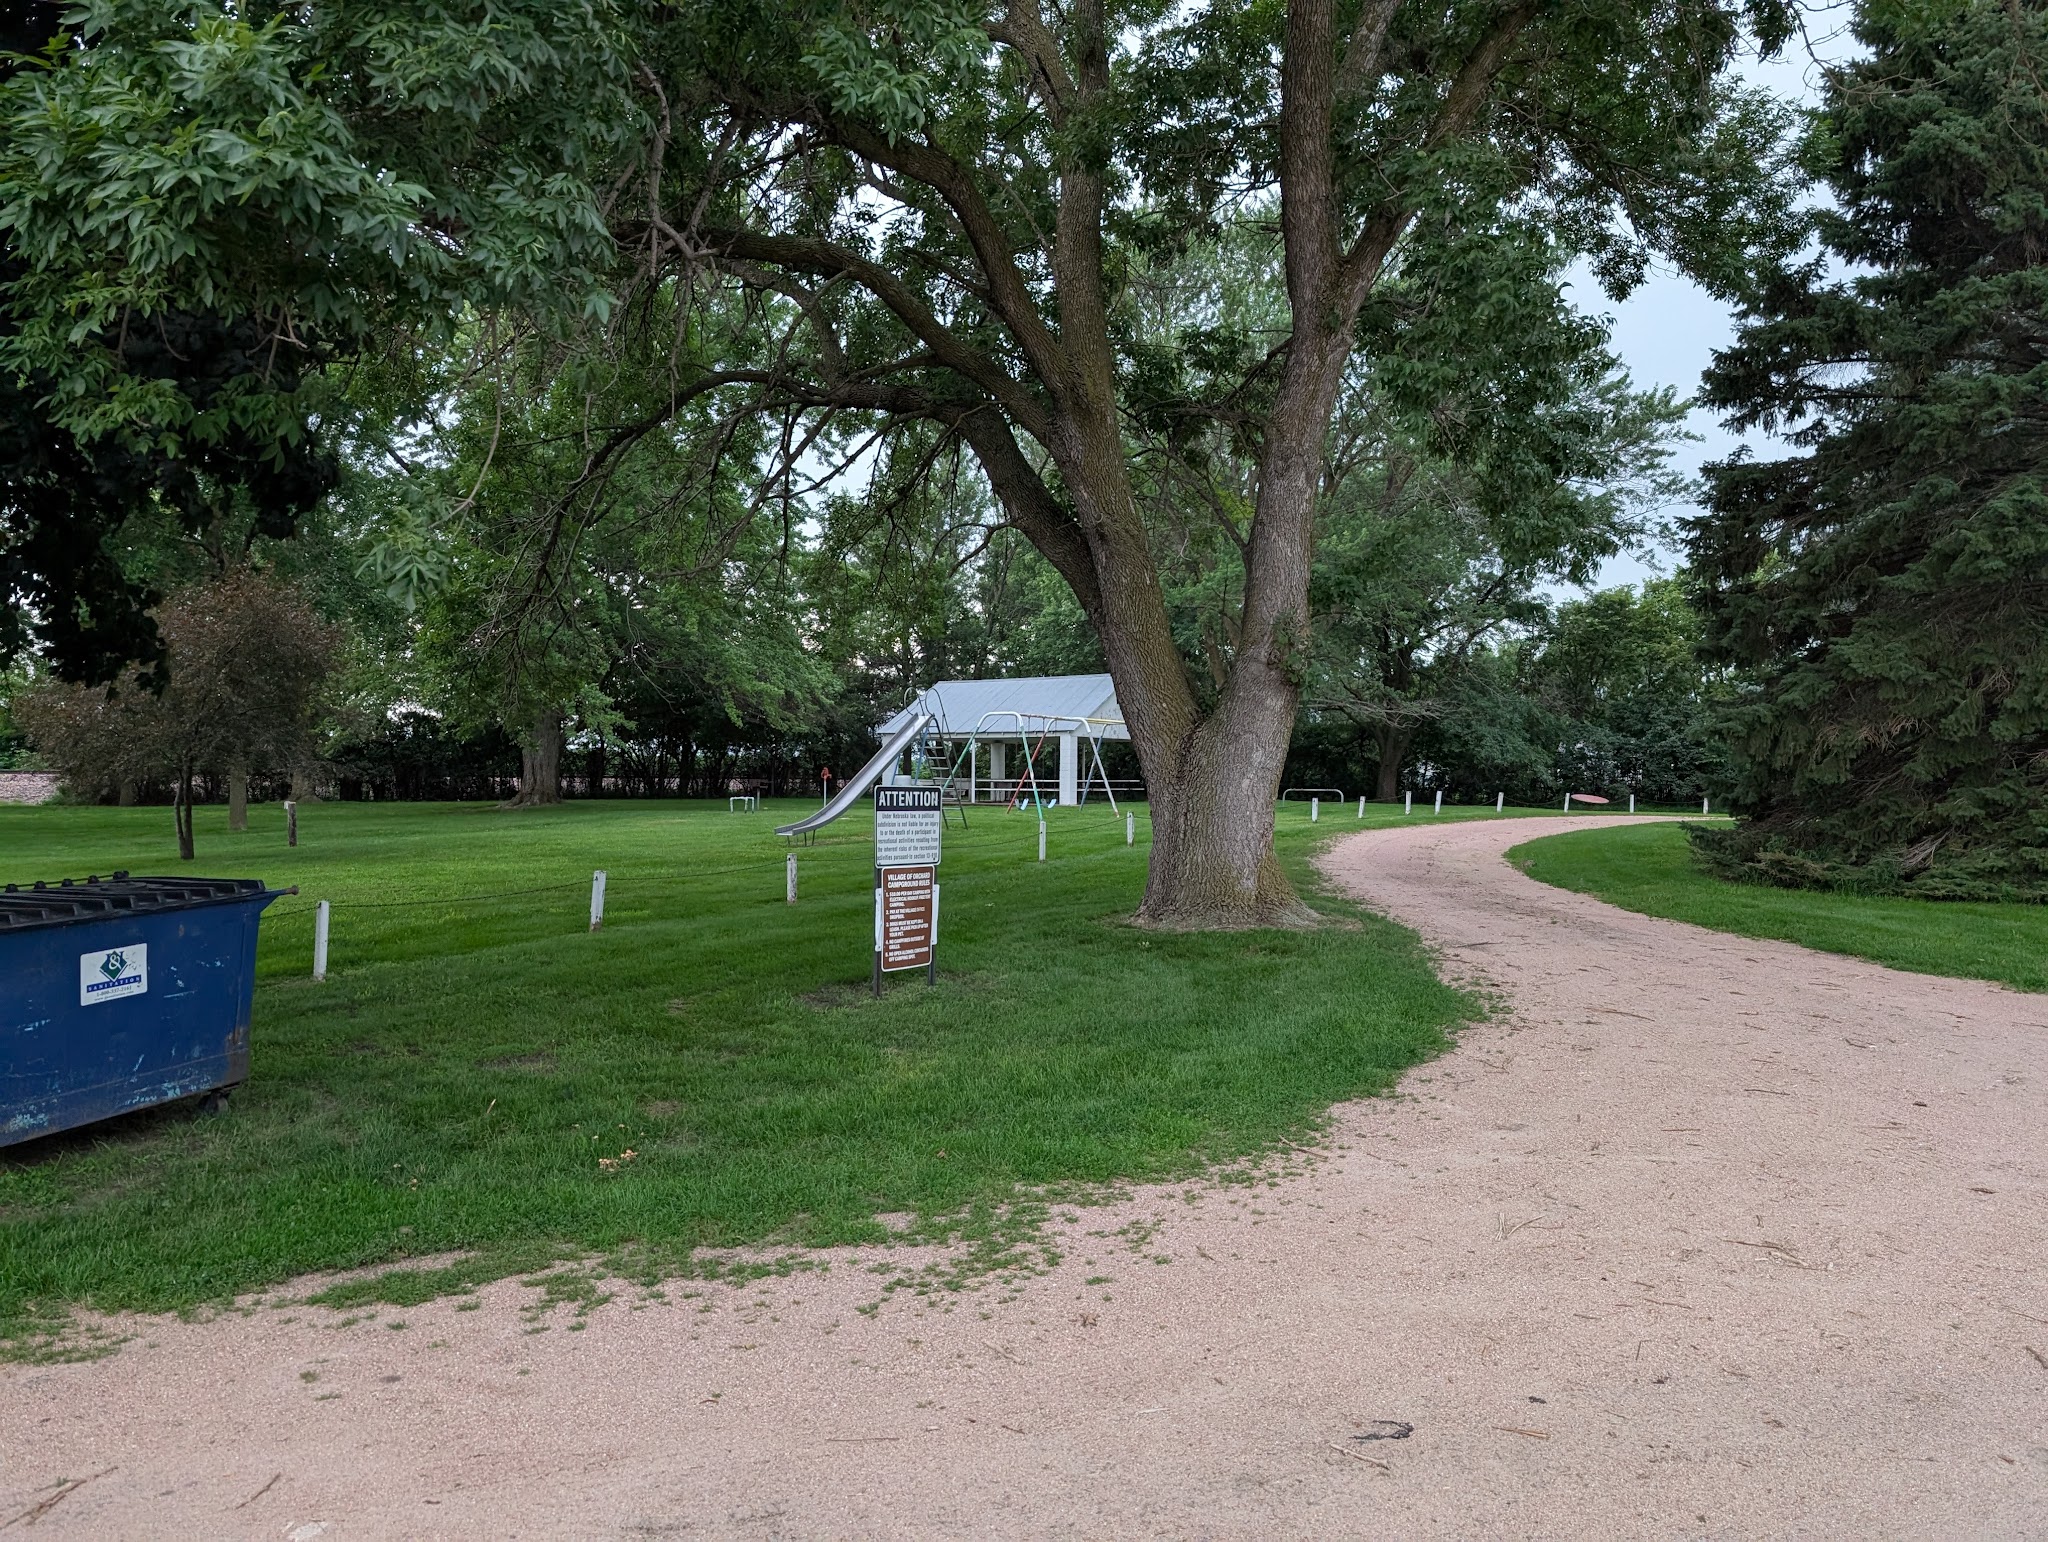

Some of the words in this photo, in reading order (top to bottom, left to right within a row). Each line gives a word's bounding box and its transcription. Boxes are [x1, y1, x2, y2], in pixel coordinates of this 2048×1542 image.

[879, 791, 938, 806] ATTENTION
[888, 880, 918, 888] CAMPGROUND
[88, 976, 140, 991] SANITATION
